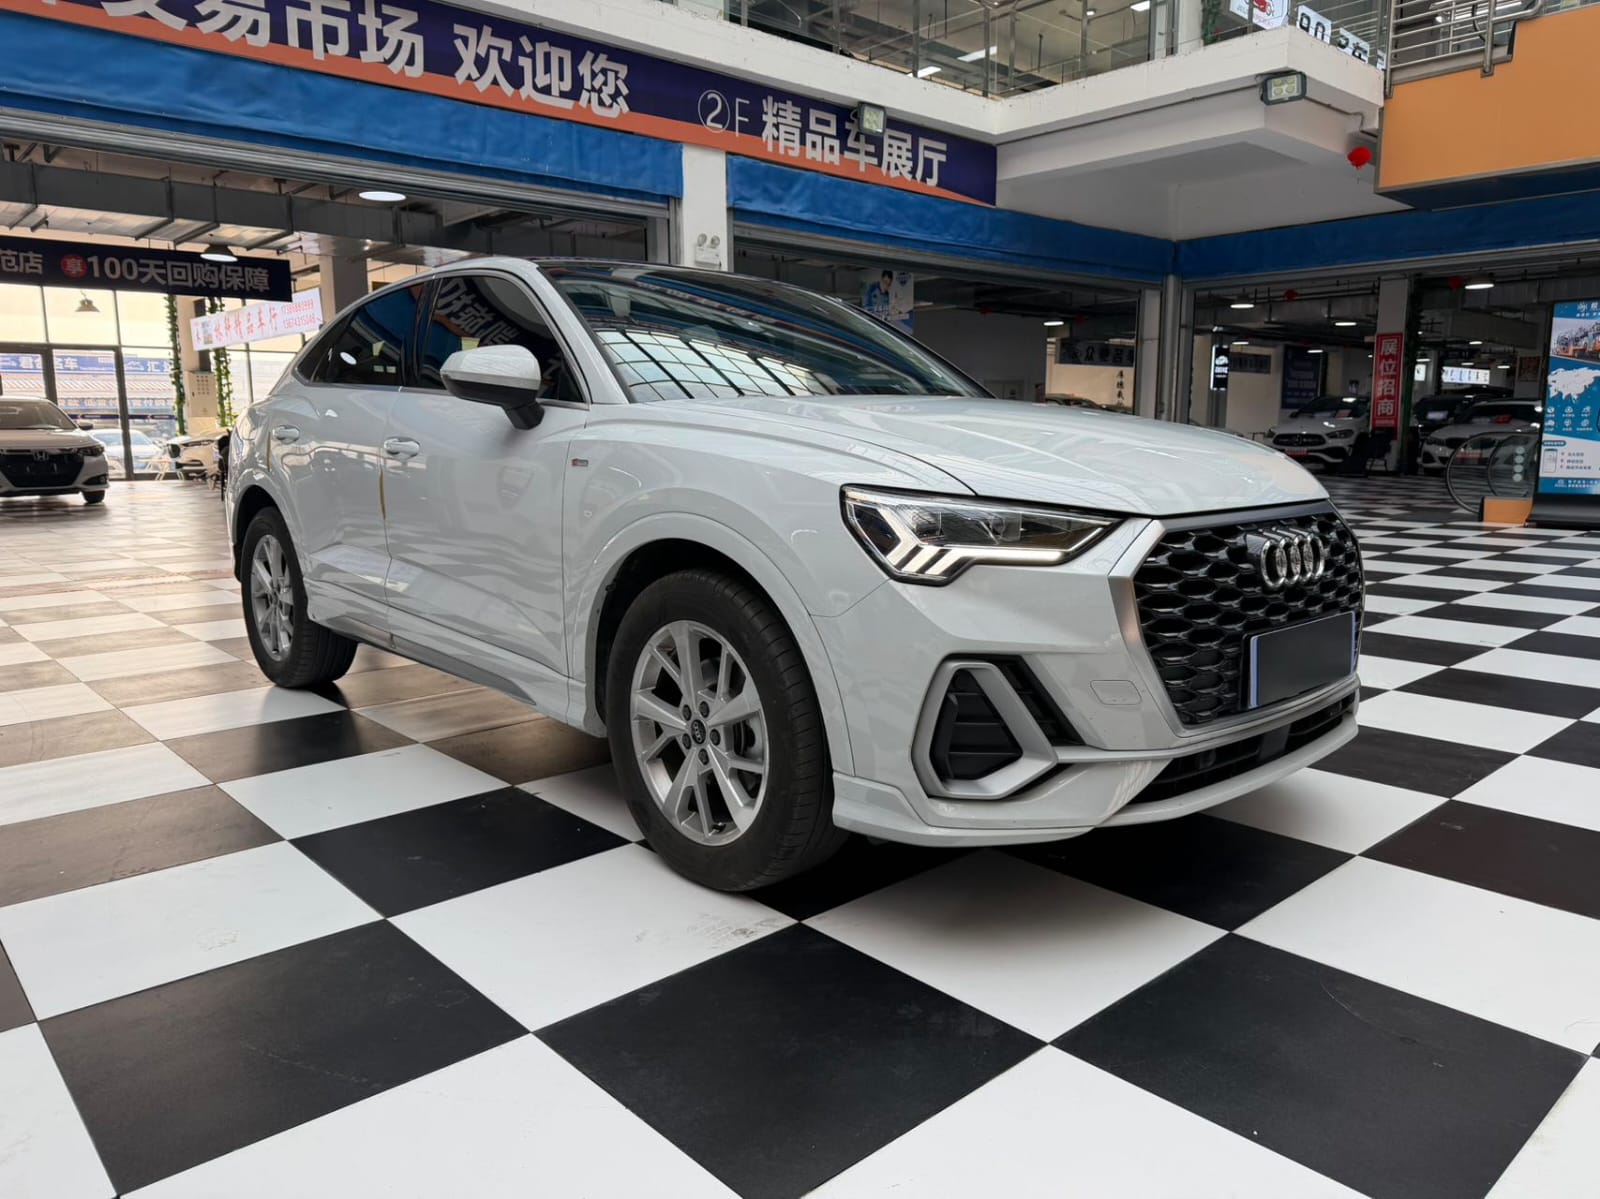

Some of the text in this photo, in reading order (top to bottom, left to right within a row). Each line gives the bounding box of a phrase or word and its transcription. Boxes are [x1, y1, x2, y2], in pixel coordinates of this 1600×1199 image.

[454, 23, 630, 118] 欢迎您
[761, 95, 948, 187] 精品车展厅
[1377, 339, 1398, 415] 展位招商
